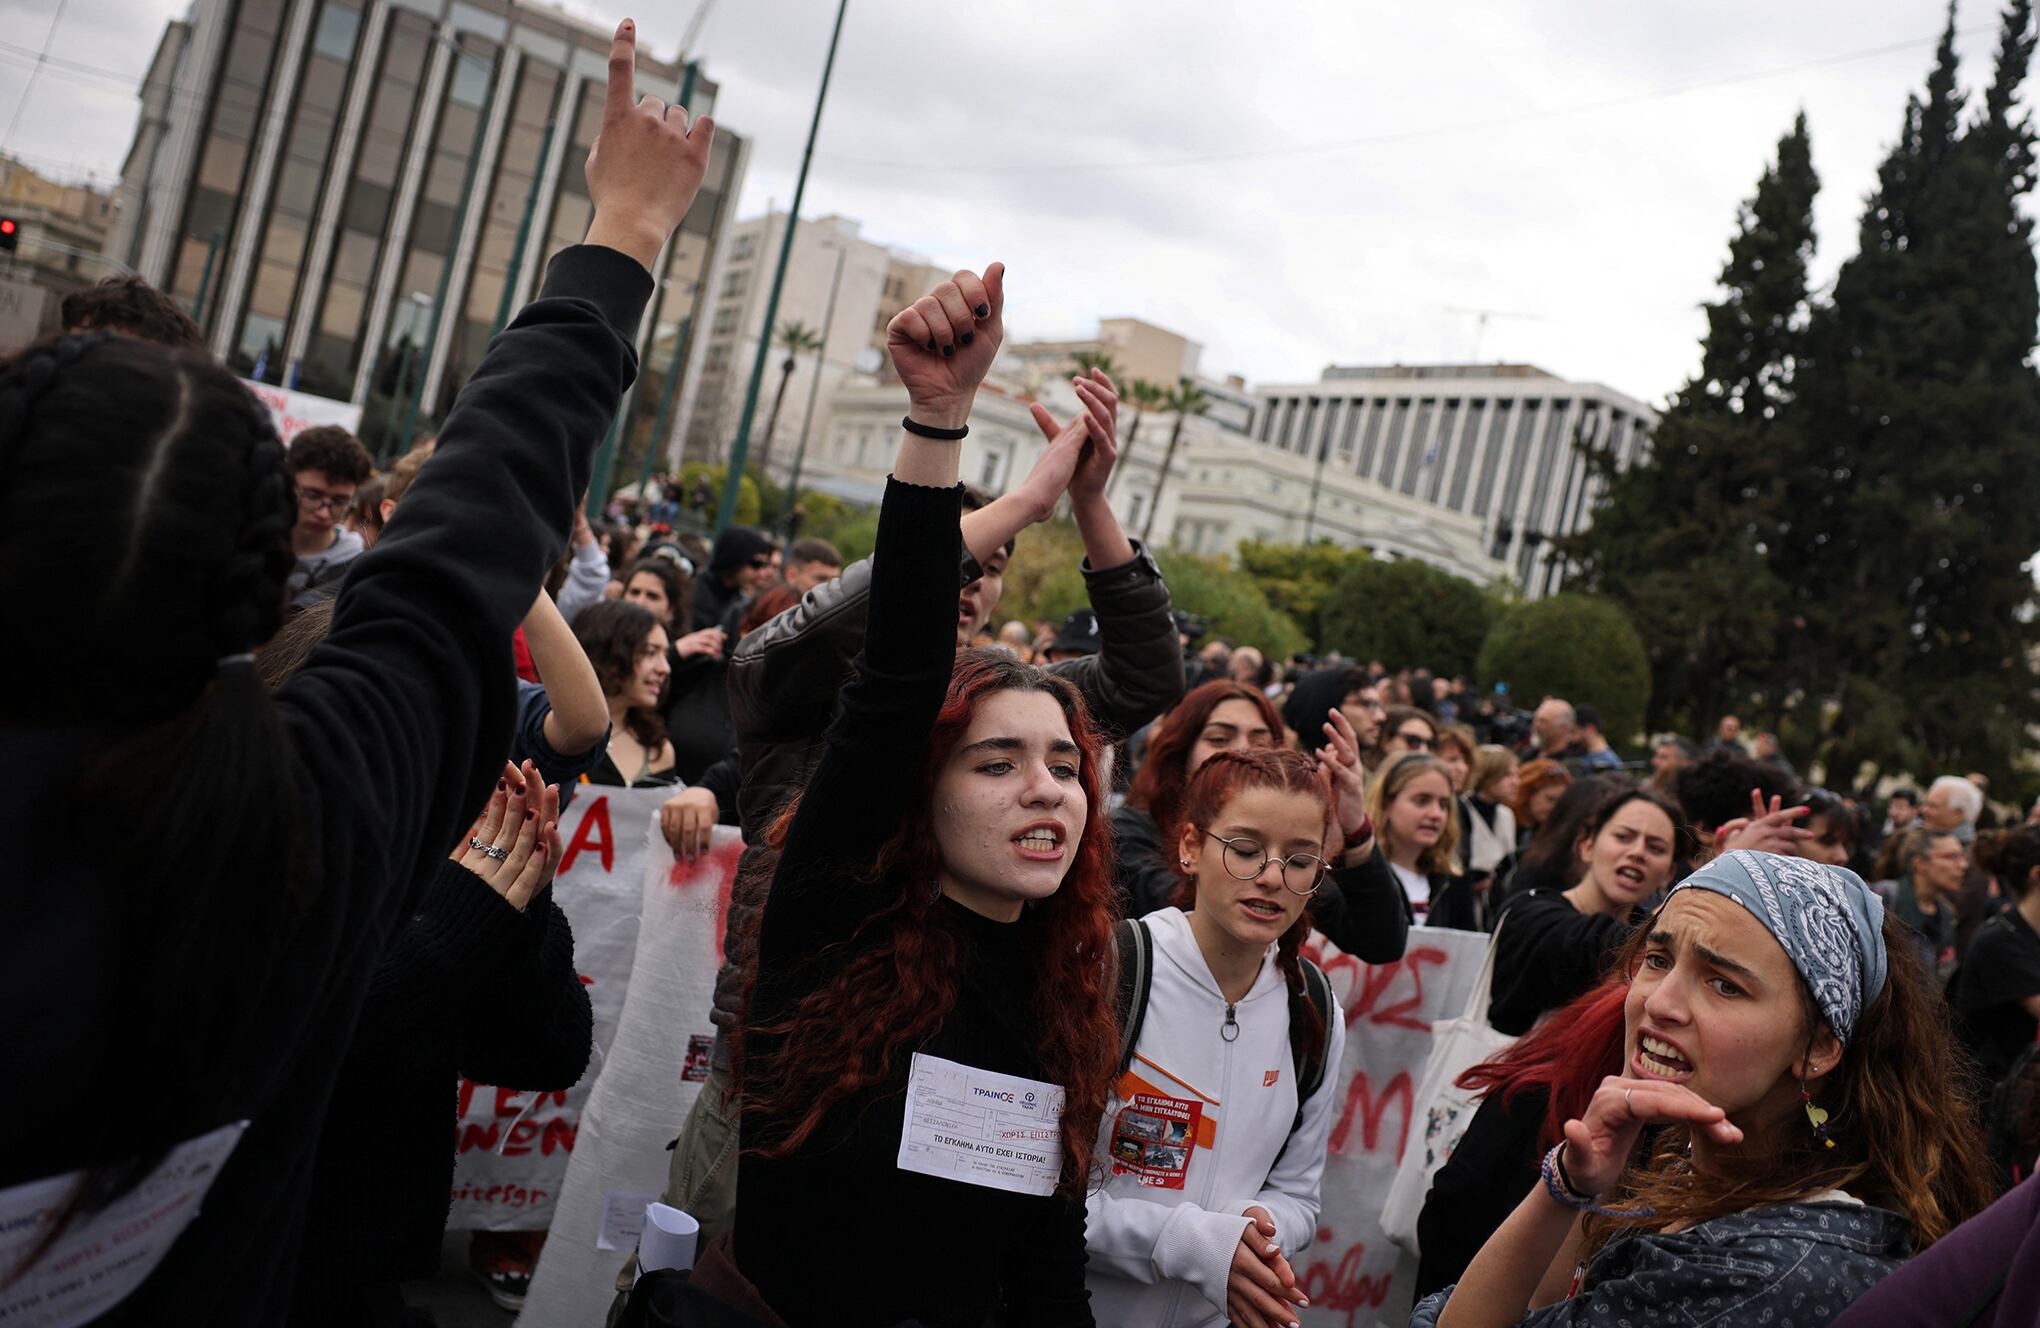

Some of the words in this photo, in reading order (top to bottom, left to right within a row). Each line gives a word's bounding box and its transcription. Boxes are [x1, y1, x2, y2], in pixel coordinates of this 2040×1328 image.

[1001, 1131, 1025, 1139] ΧΩΡΙΣ
[934, 1134, 943, 1144] ΤΟ
[944, 1136, 974, 1151] ΕΓΚΛΗΜΑ
[975, 1144, 994, 1155] ΑΥΤΟ
[996, 1148, 1013, 1159] ΕΧΕΙ
[1015, 1151, 1046, 1164] ΙΣΤΟΡΙΑ!
